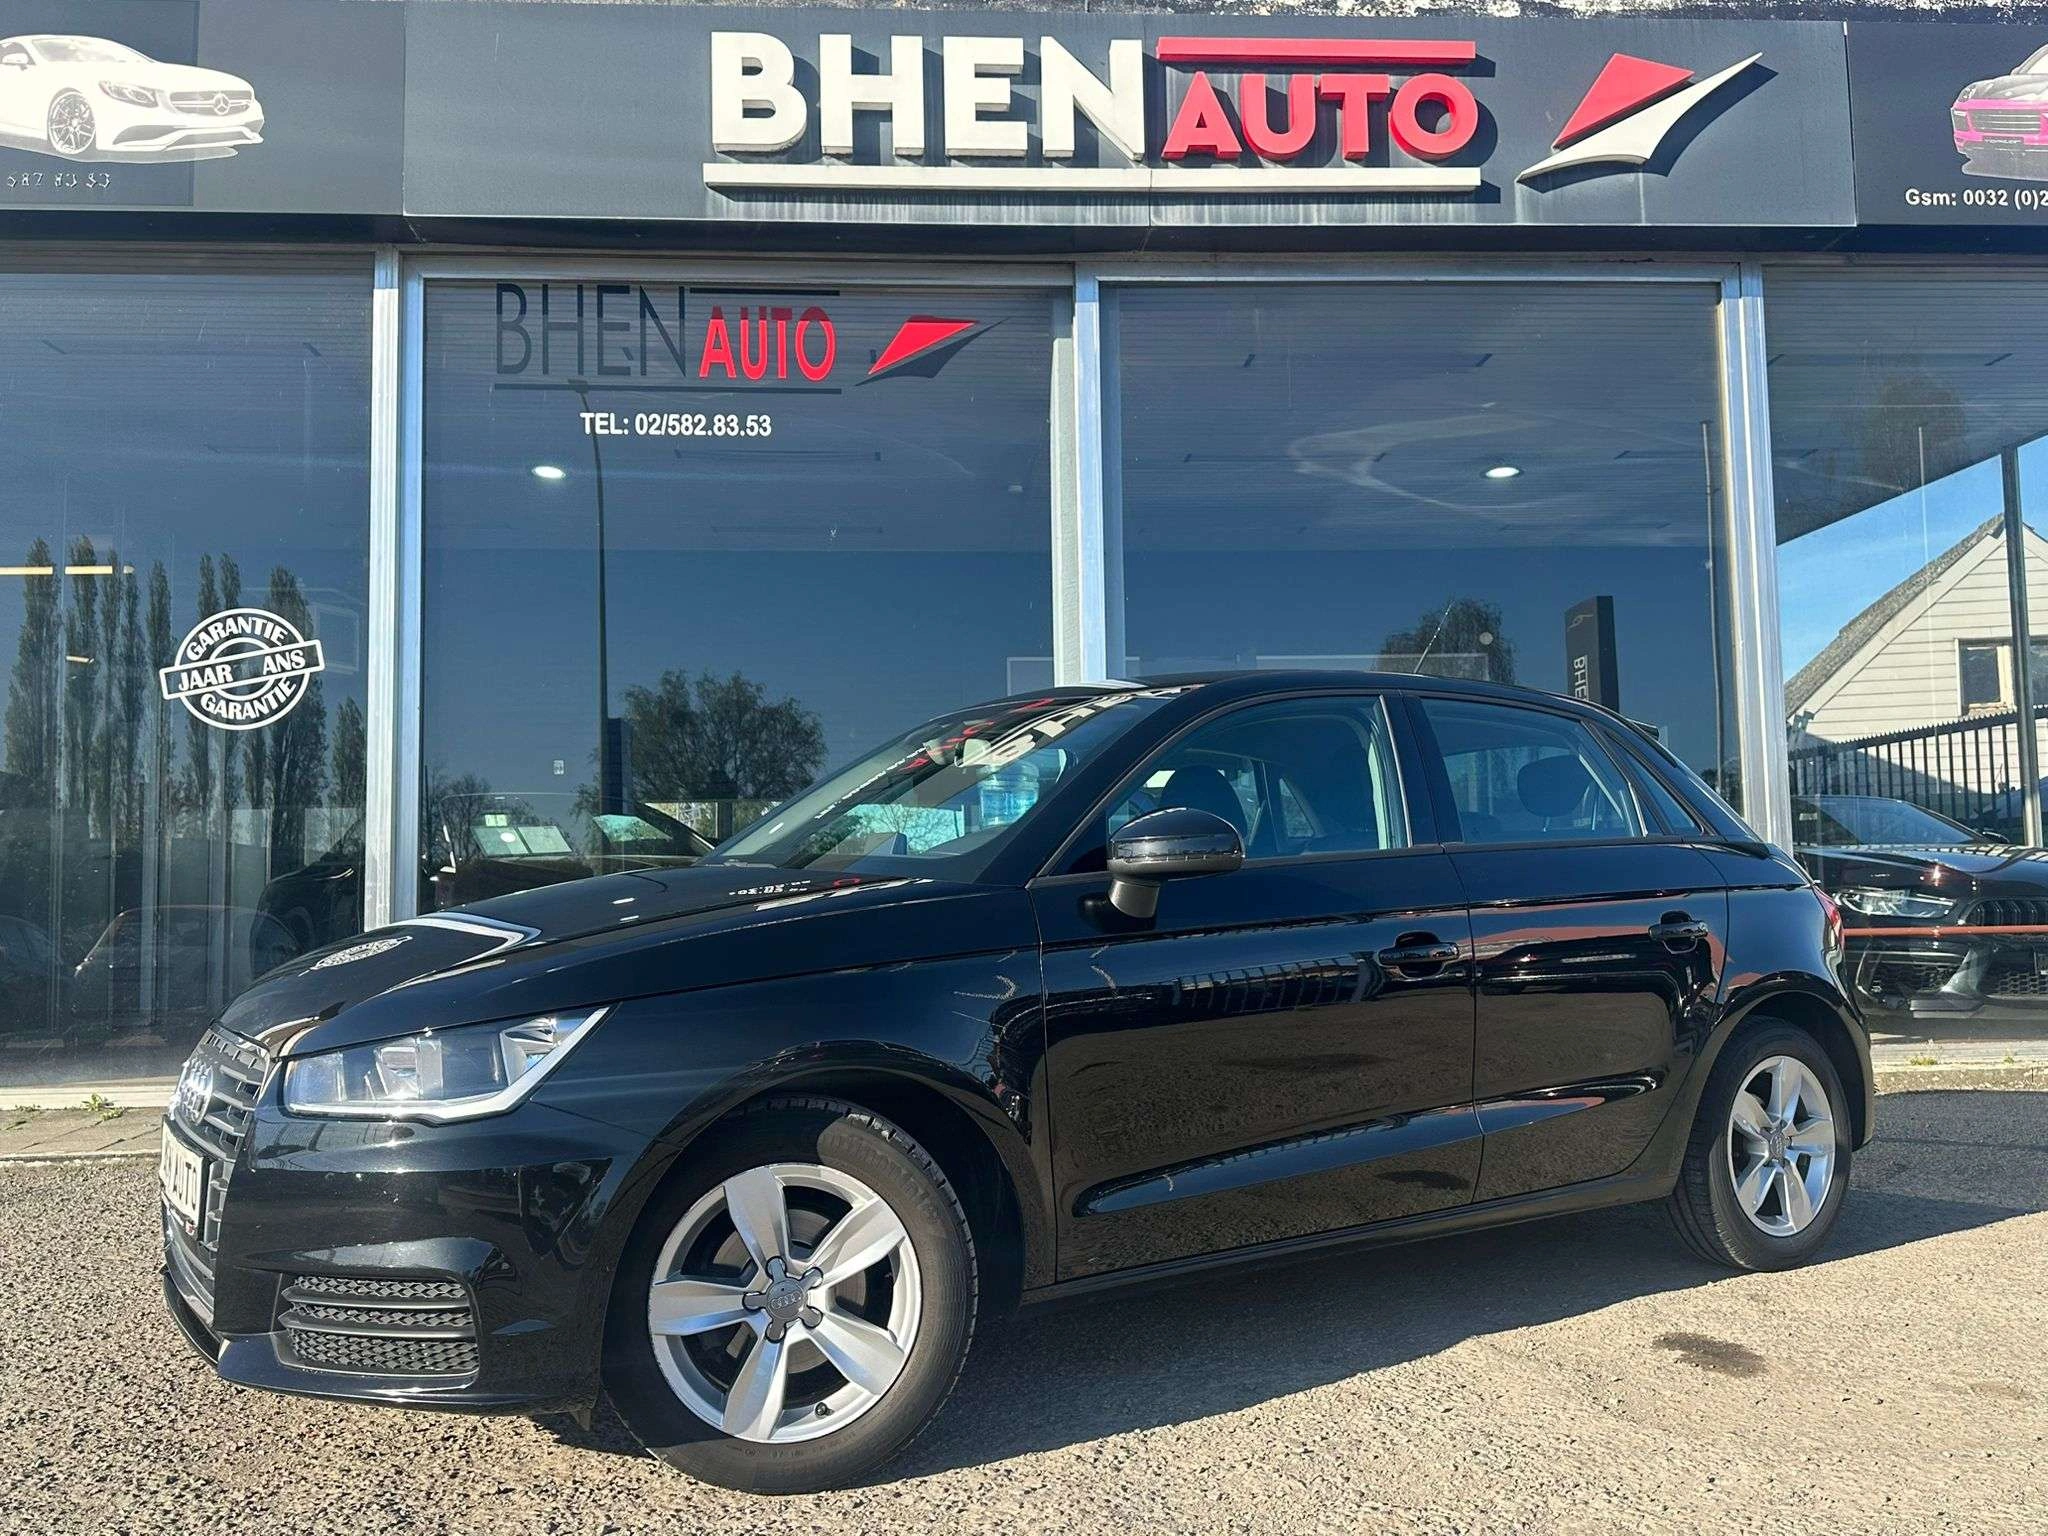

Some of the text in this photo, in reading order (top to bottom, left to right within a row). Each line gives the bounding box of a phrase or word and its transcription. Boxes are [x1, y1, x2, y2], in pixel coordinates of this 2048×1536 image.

[711, 32, 1479, 160] BHEN AUTO
[1905, 188, 1957, 206] Gsm:
[1963, 189, 2009, 206] 0032
[496, 283, 837, 381] BHEN AUTO
[580, 412, 773, 436] TEL: 02/582.83.53
[187, 616, 288, 661] GARANTIE
[179, 650, 306, 691] JAAR ANS
[201, 676, 296, 720] GARANTIE
